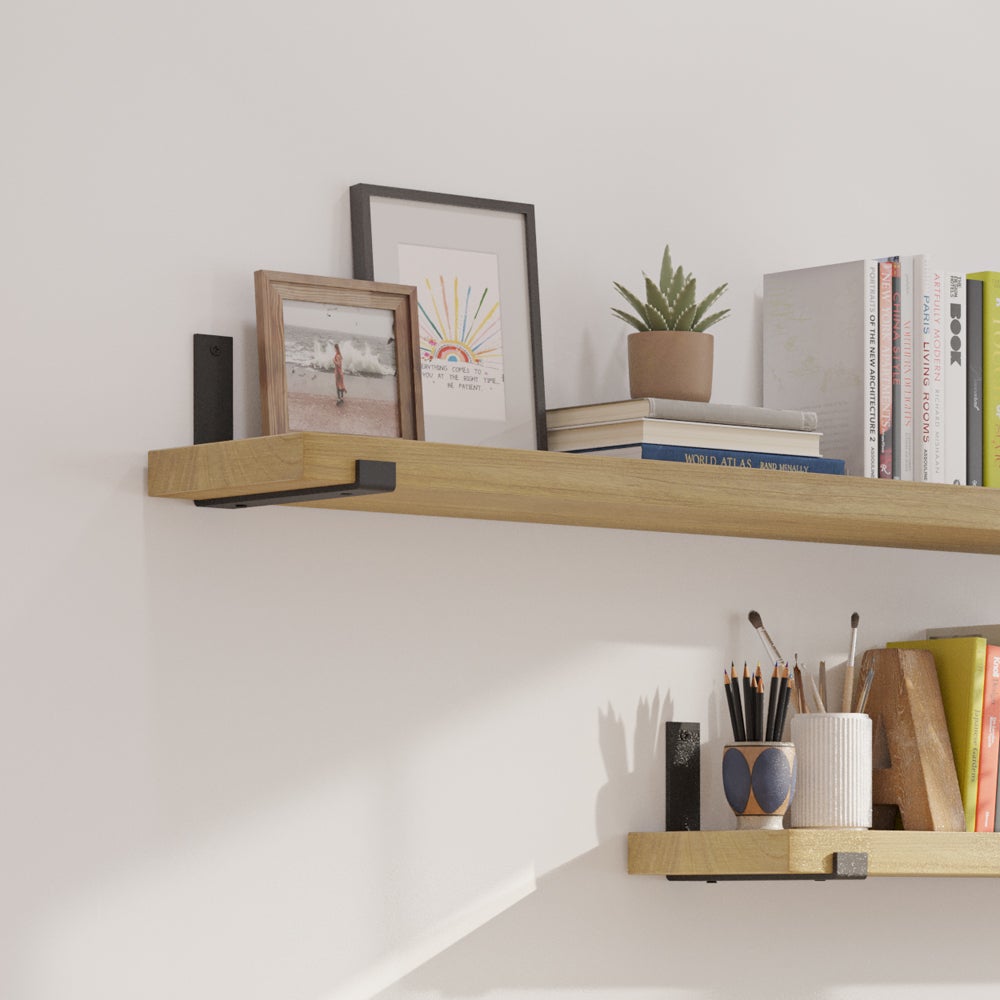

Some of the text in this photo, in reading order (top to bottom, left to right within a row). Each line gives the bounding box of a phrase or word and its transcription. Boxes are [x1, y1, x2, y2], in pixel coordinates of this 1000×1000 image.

[880, 272, 891, 302] NEW
[869, 314, 876, 326] OF
[880, 306, 891, 340] YORK
[933, 273, 941, 382] ARTFULLY MODERN
[950, 303, 962, 367] BOOK
[893, 292, 901, 385] CHINA STYLE
[880, 344, 891, 427] APARTMENTS
[684, 453, 717, 466] WORLD
[721, 456, 753, 469] ATLAS
[759, 461, 777, 471] RAND
[992, 656, 1000, 677] Knoll
[971, 747, 979, 783] Gardens
